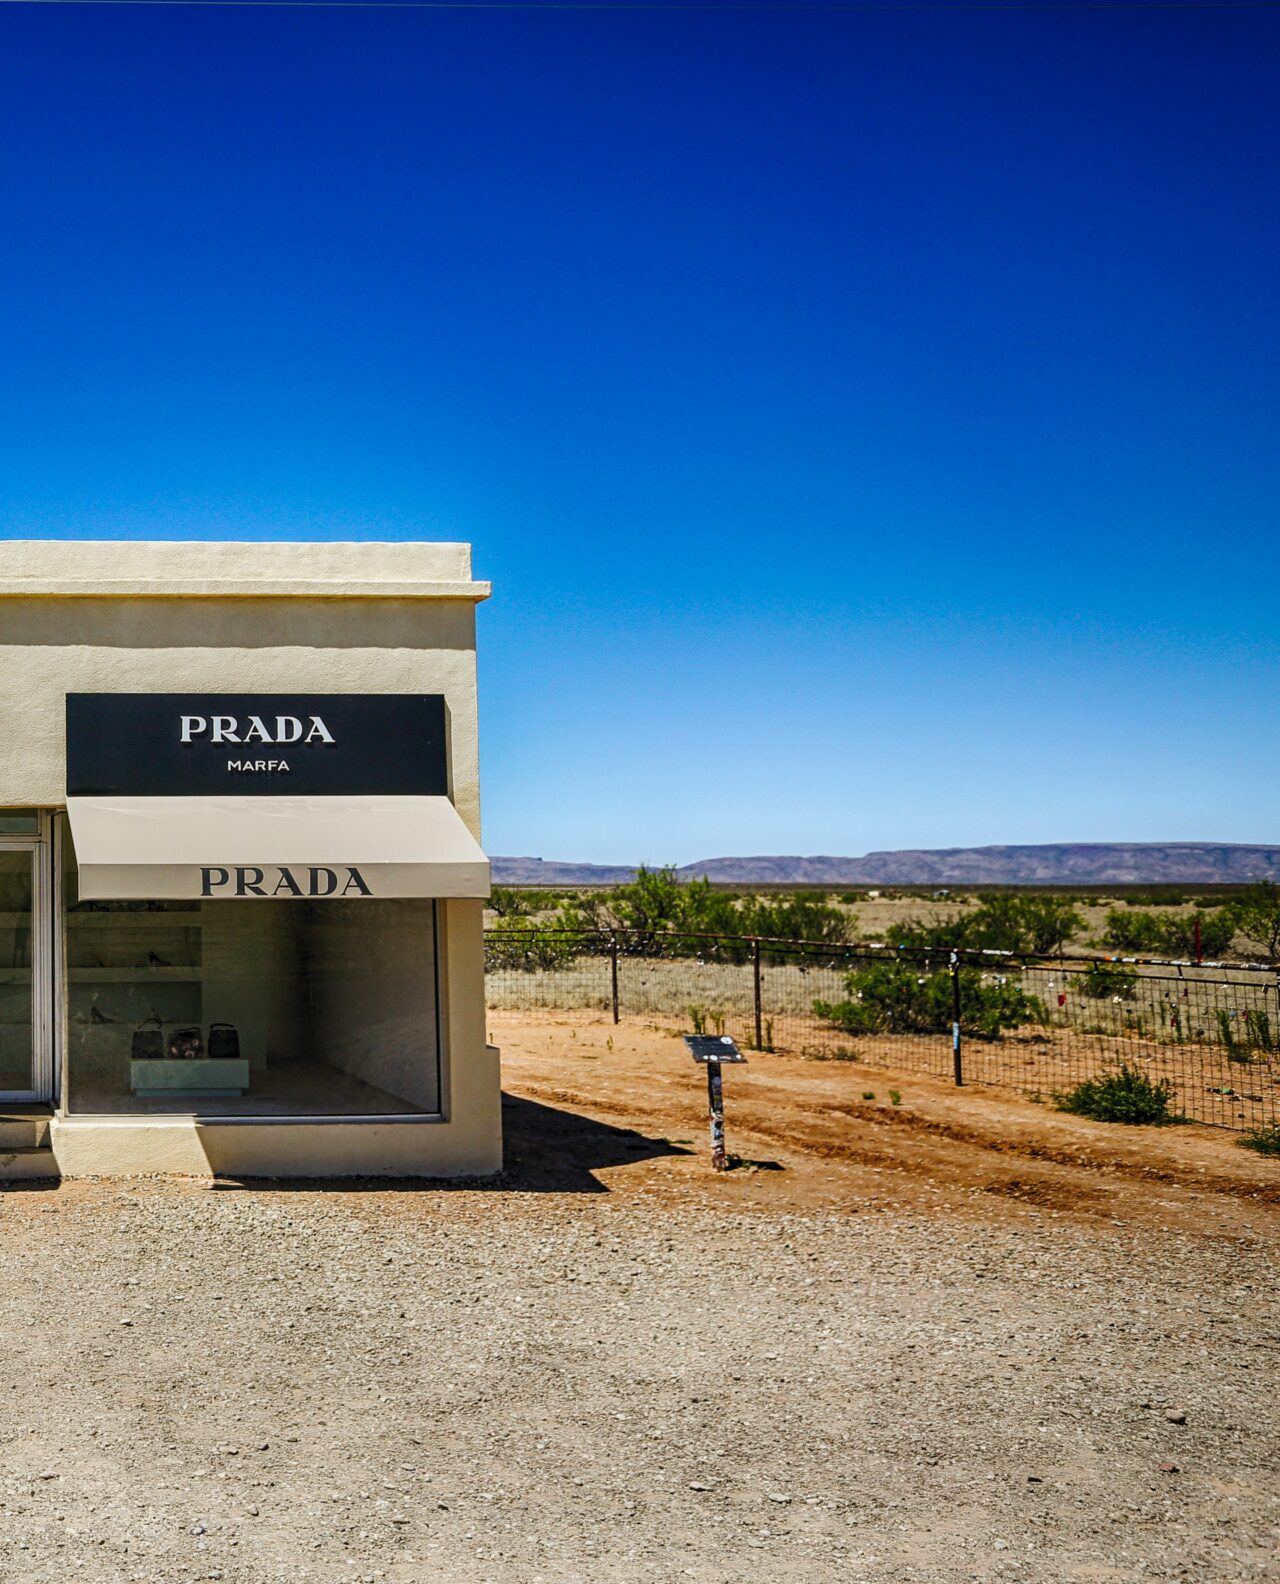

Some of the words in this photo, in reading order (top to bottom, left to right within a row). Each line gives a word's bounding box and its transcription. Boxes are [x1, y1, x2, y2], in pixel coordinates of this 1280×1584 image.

[180, 716, 336, 743] PRADA
[228, 761, 290, 771] MARFA
[200, 867, 374, 897] PRADA
